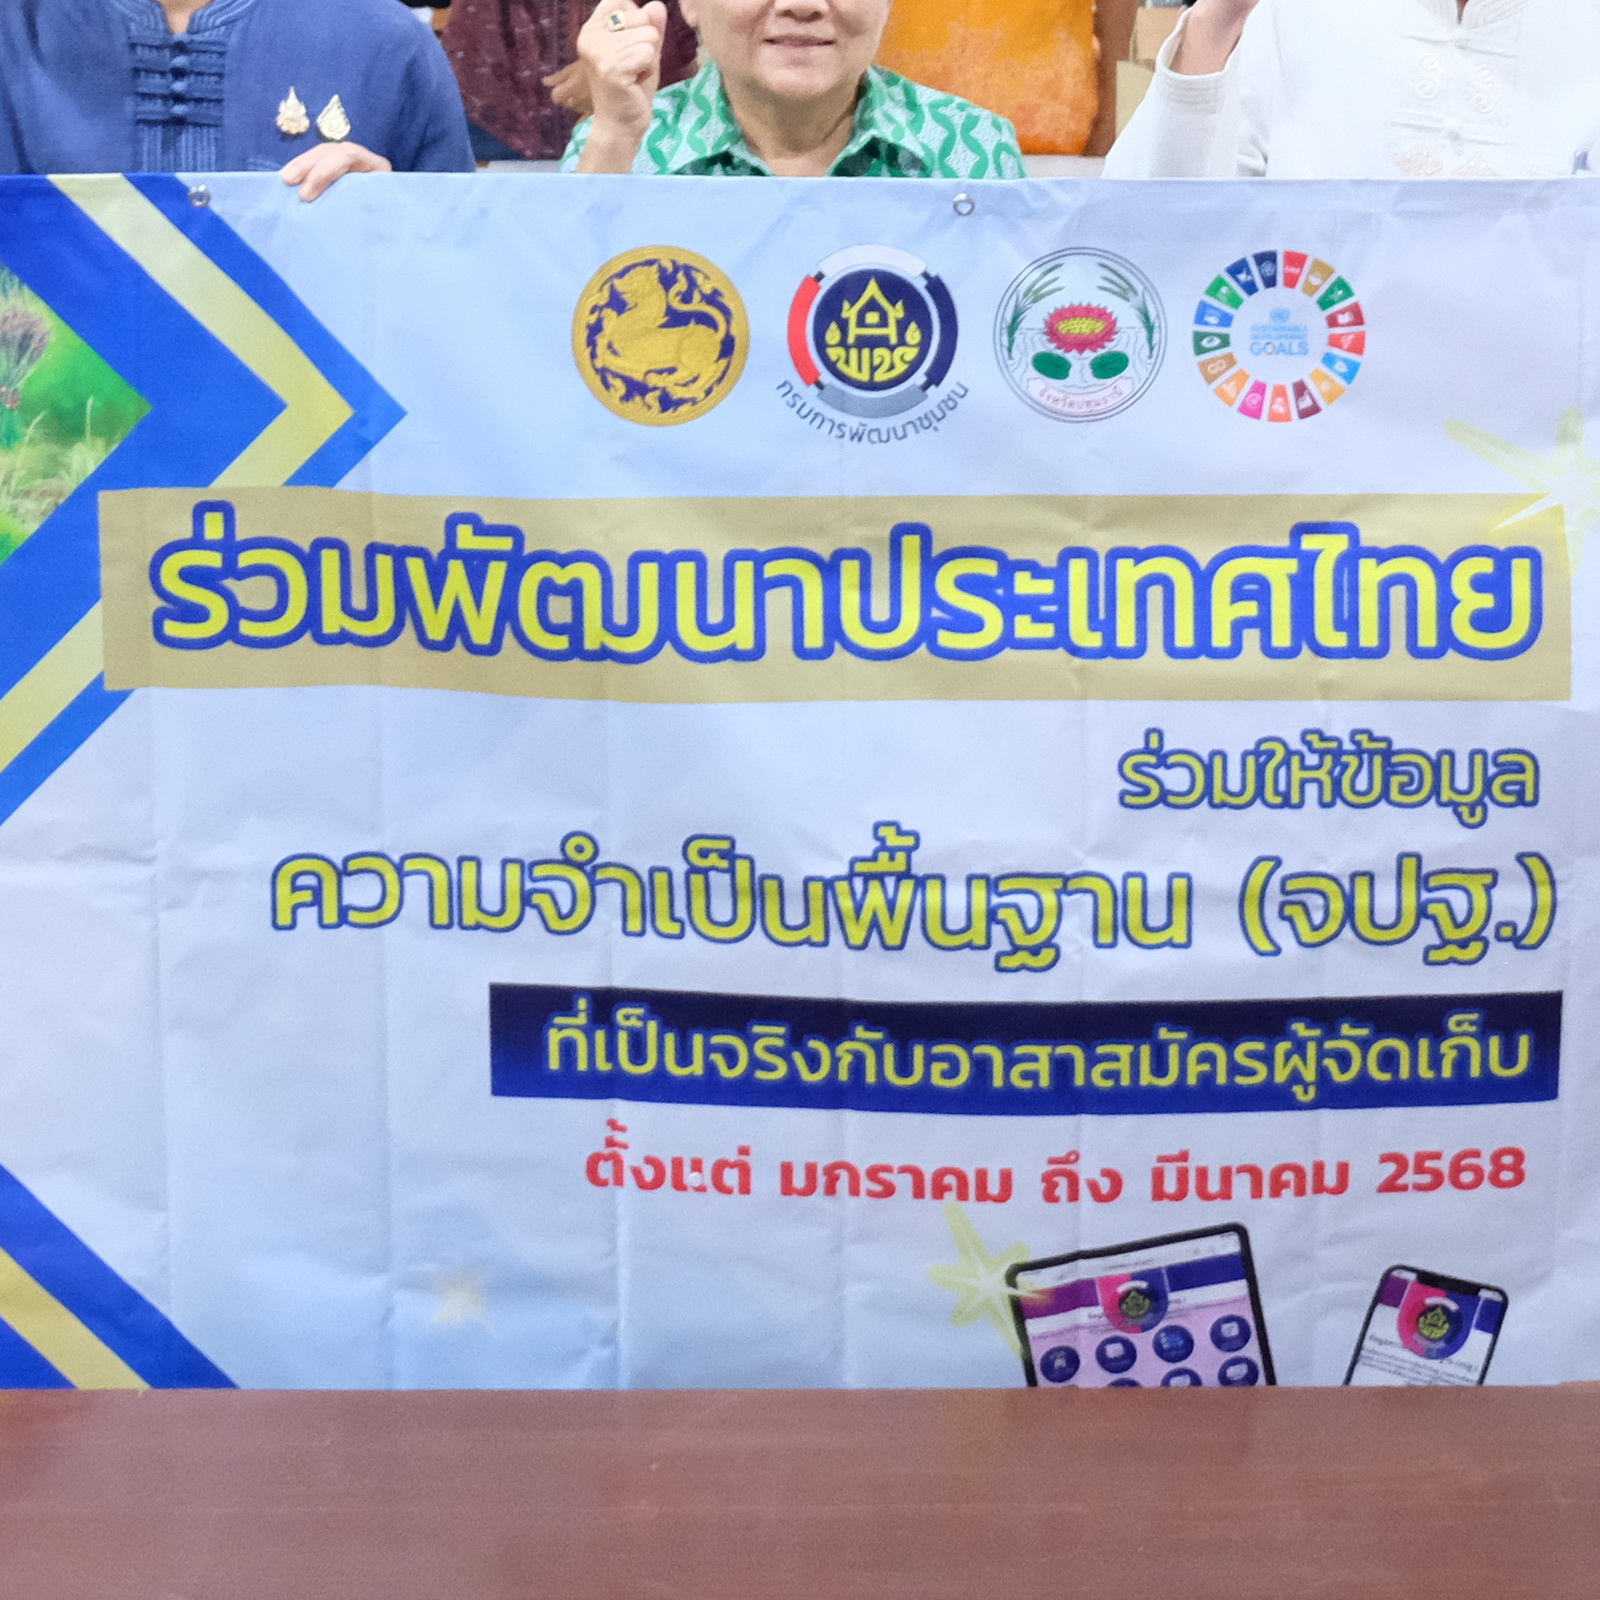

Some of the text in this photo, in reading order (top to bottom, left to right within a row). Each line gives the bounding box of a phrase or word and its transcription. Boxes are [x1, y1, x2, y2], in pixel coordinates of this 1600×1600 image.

[776, 380, 969, 444] กรมการพัฒนาชุมชน
[150, 501, 1541, 663] ร่วมพัฒนาประเทศไทย
[1118, 728, 1539, 828] ร่วมให้ข้อมูล
[271, 821, 1557, 972] ความจำเป็นพื้นฐาน (จปฐ.)
[547, 998, 1531, 1101] ที่เป็นจริงกับอาสาสมัครผู้จัดเก็บ
[586, 1118, 1525, 1203] ตั้งแต่ มกราคม ถึง มีนาคม 2568
